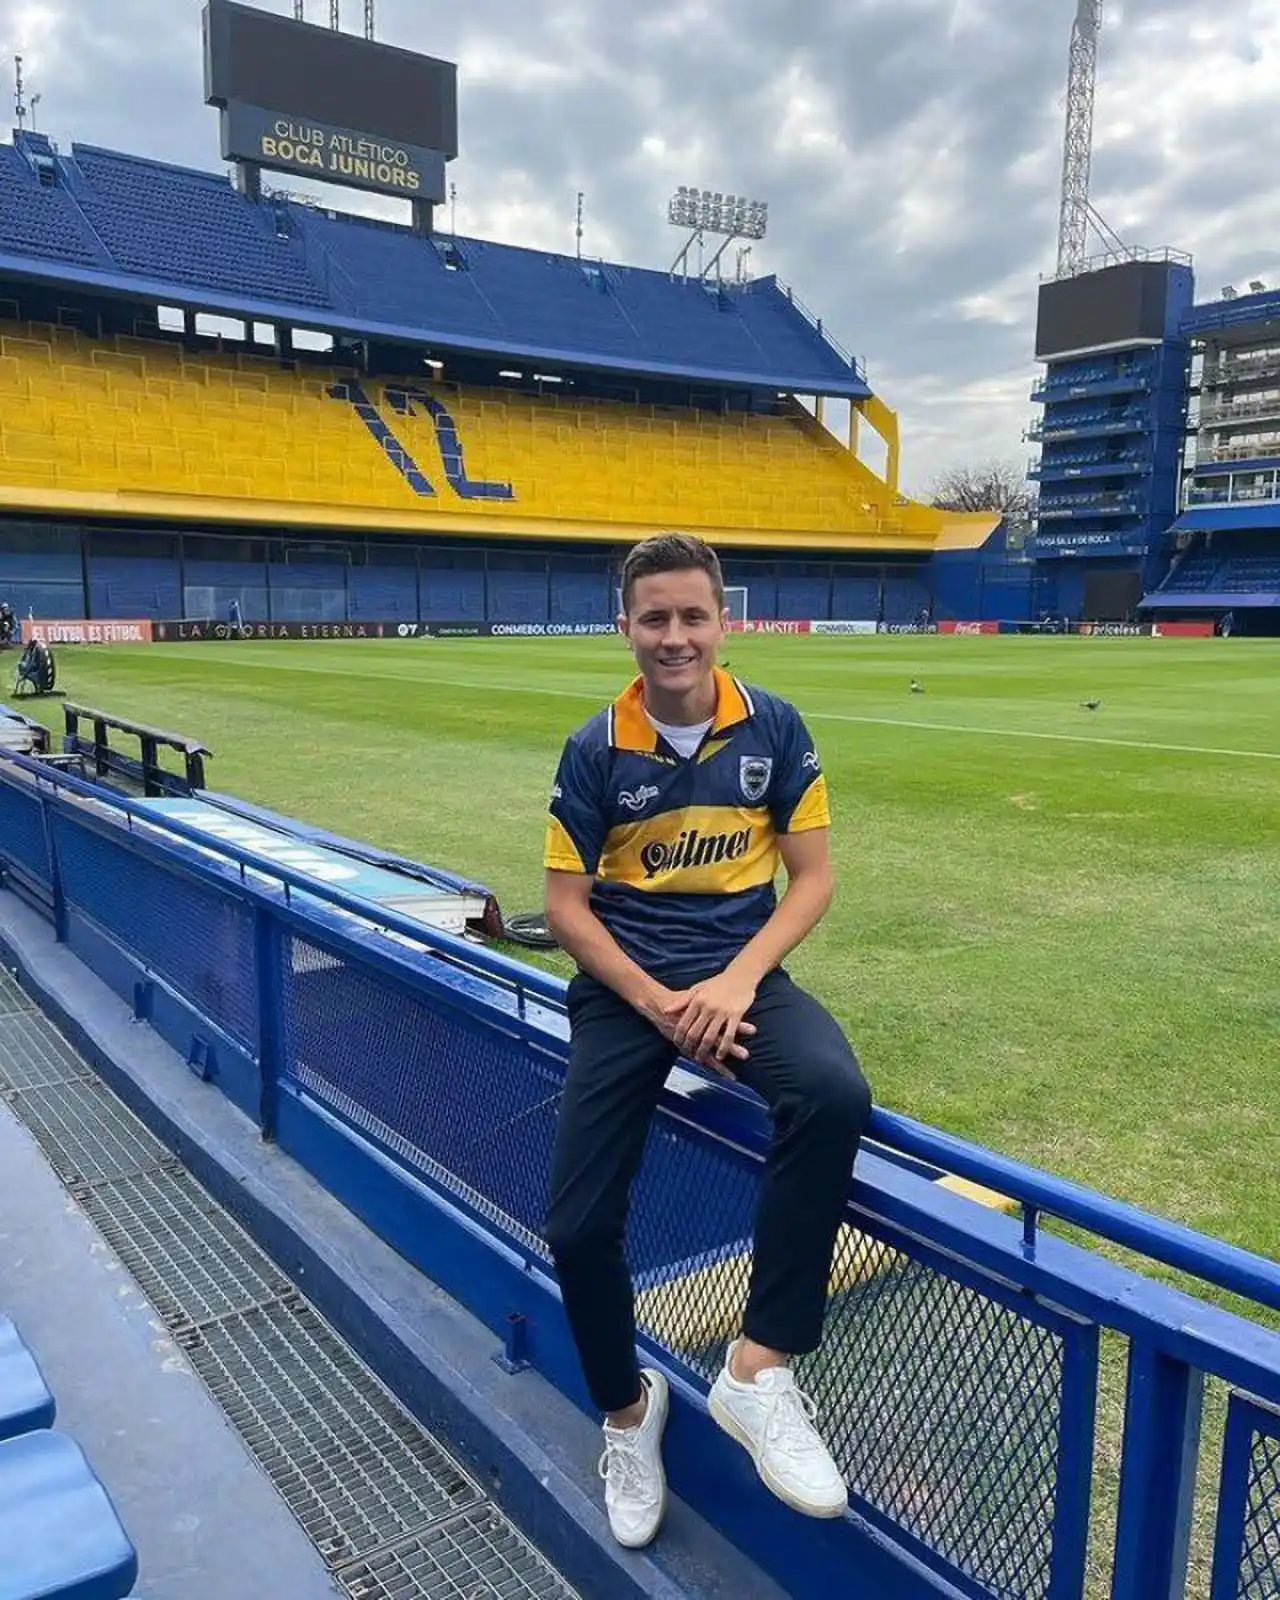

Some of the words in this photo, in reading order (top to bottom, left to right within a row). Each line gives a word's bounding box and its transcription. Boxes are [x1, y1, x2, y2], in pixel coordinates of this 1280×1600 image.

[275, 120, 324, 147] CLUB
[329, 134, 409, 167] ATLÉTICO
[261, 136, 324, 168] BOCA
[330, 153, 420, 189] JUNIORS
[179, 624, 202, 638] LA
[302, 625, 367, 637] ETERNA
[491, 623, 545, 635] CONMEBOL
[546, 623, 574, 635] COPA
[756, 621, 799, 634] AMSTEL
